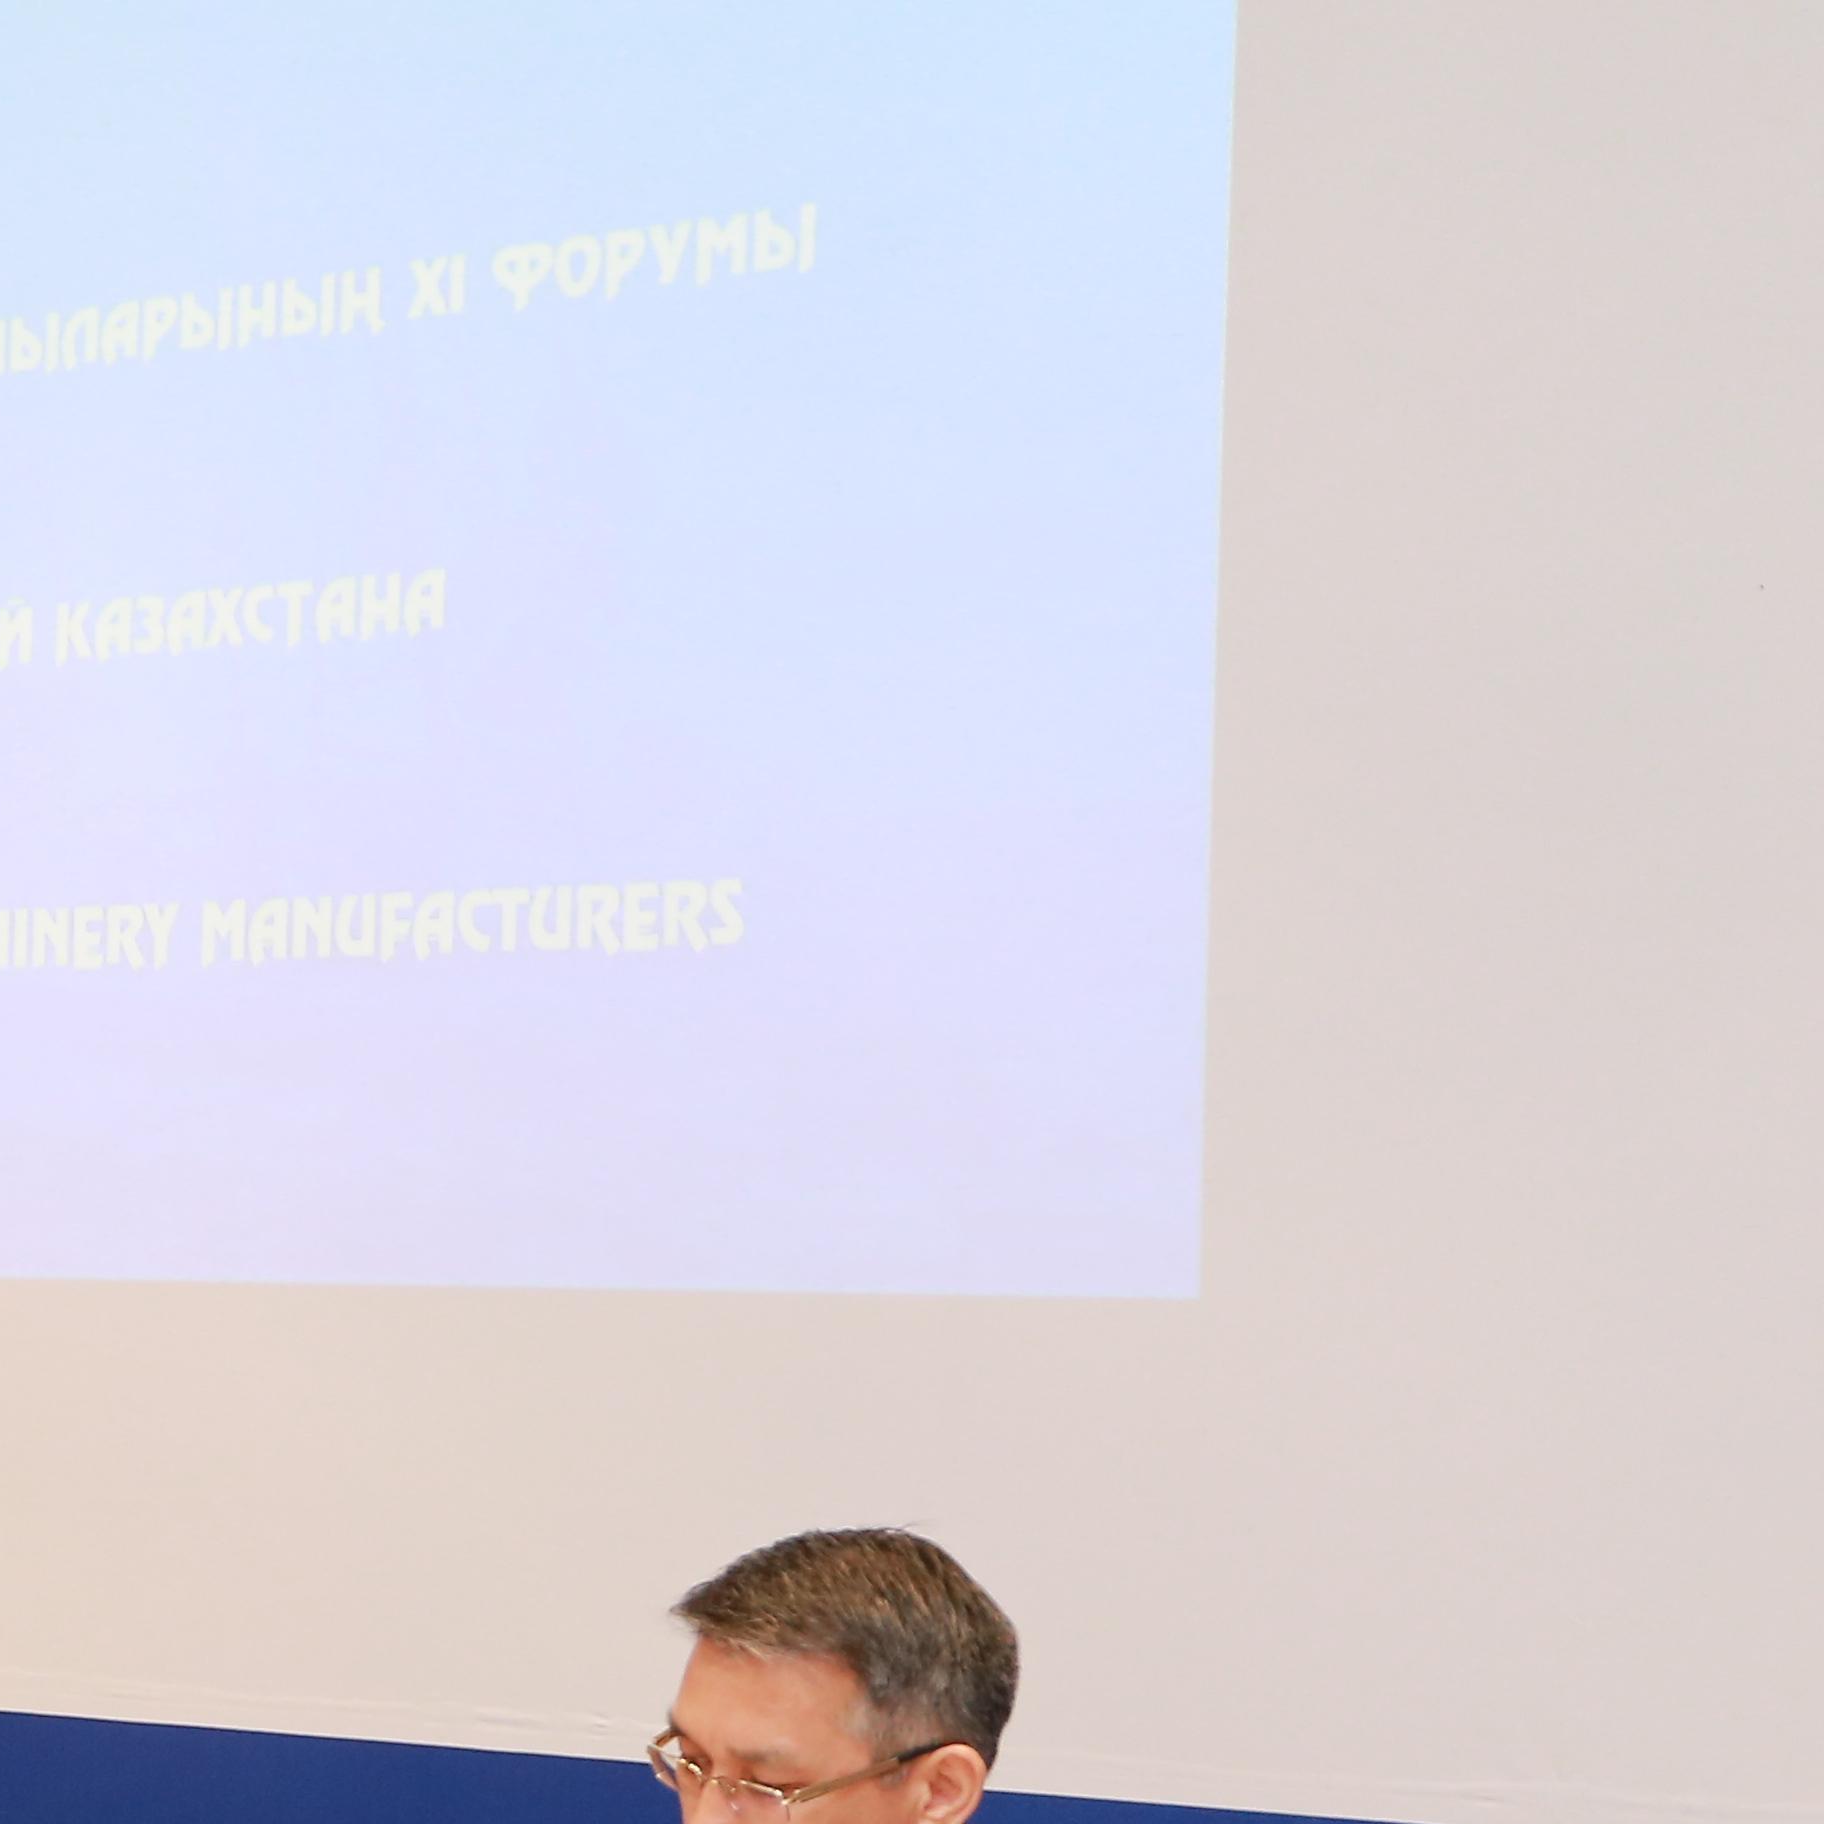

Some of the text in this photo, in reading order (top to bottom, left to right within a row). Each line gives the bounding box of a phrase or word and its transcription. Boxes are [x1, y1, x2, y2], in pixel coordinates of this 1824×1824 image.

[491, 202, 816, 312] ФОРУМЫ
[55, 568, 446, 668] КАЗАХСТАНА
[201, 878, 745, 969] MANUFACTURERS
